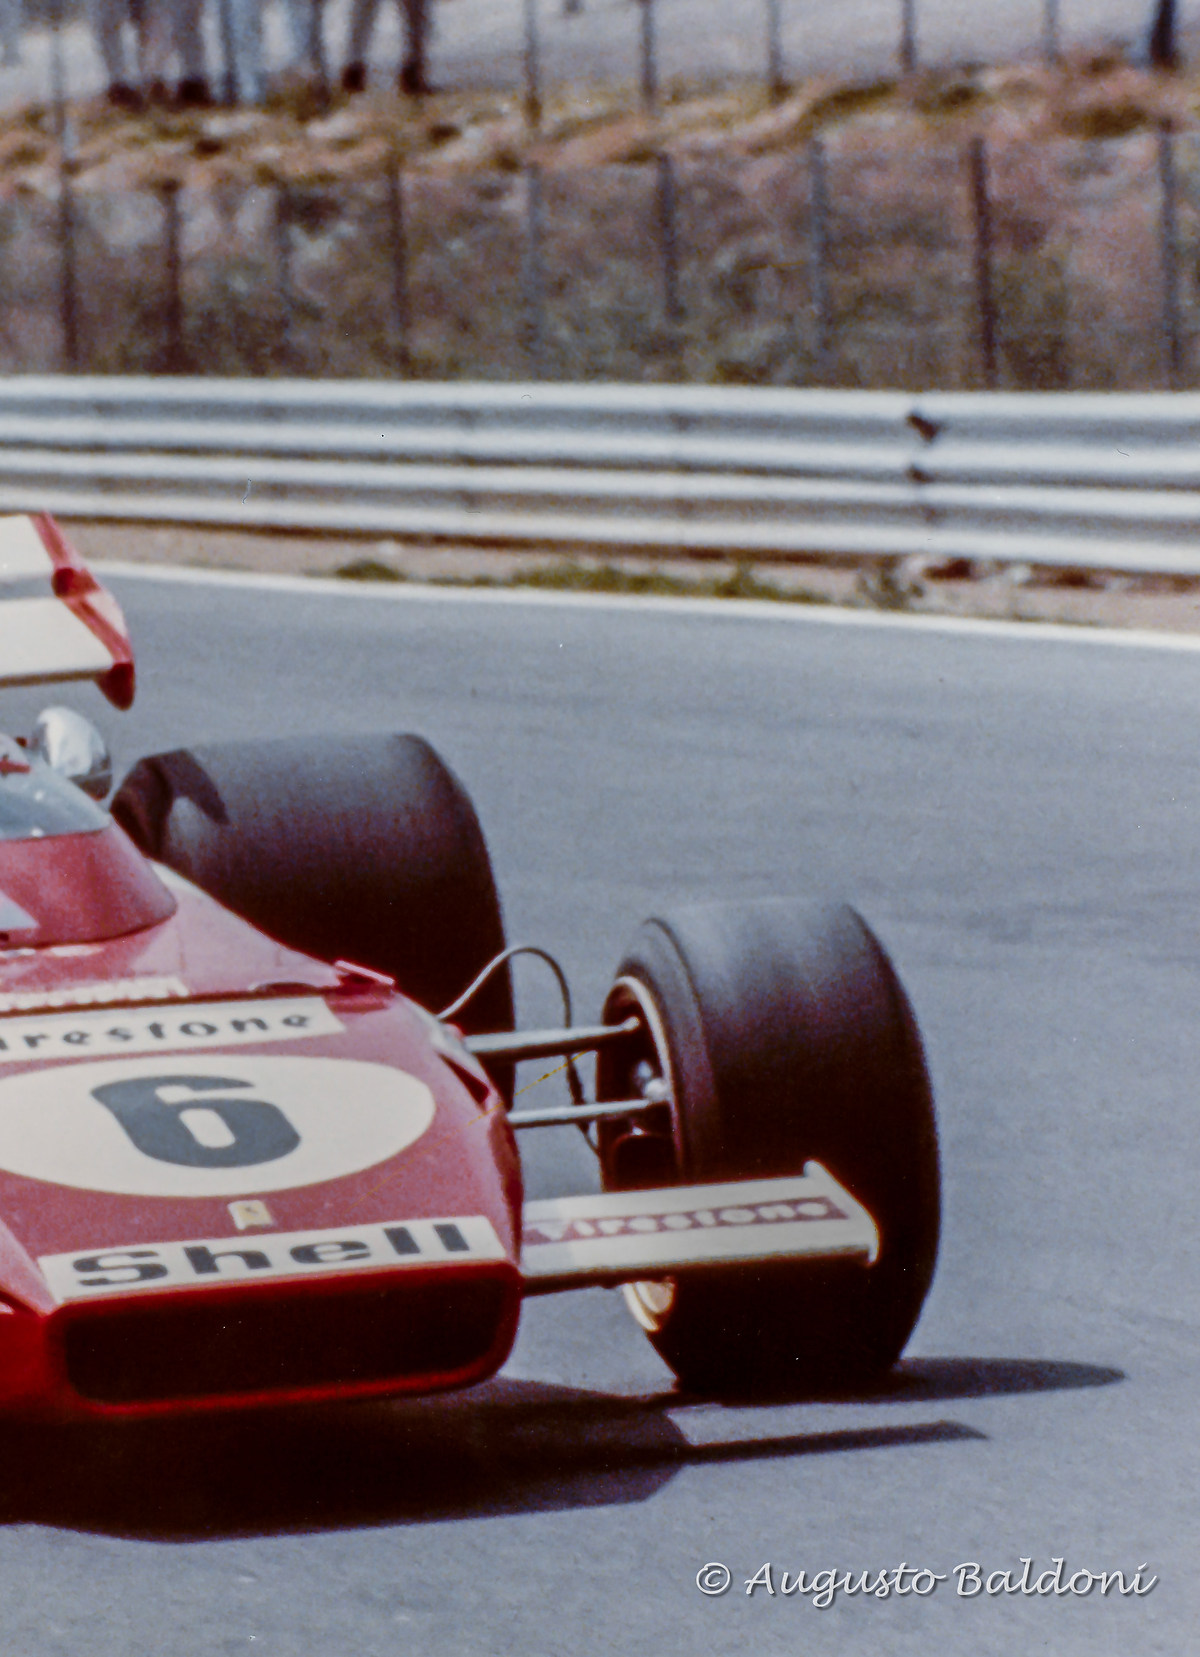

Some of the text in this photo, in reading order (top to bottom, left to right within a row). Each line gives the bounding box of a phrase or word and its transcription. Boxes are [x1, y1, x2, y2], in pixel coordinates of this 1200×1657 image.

[89, 1074, 302, 1168] 6
[525, 1201, 830, 1241] Firestone
[72, 1222, 471, 1288] Shell
